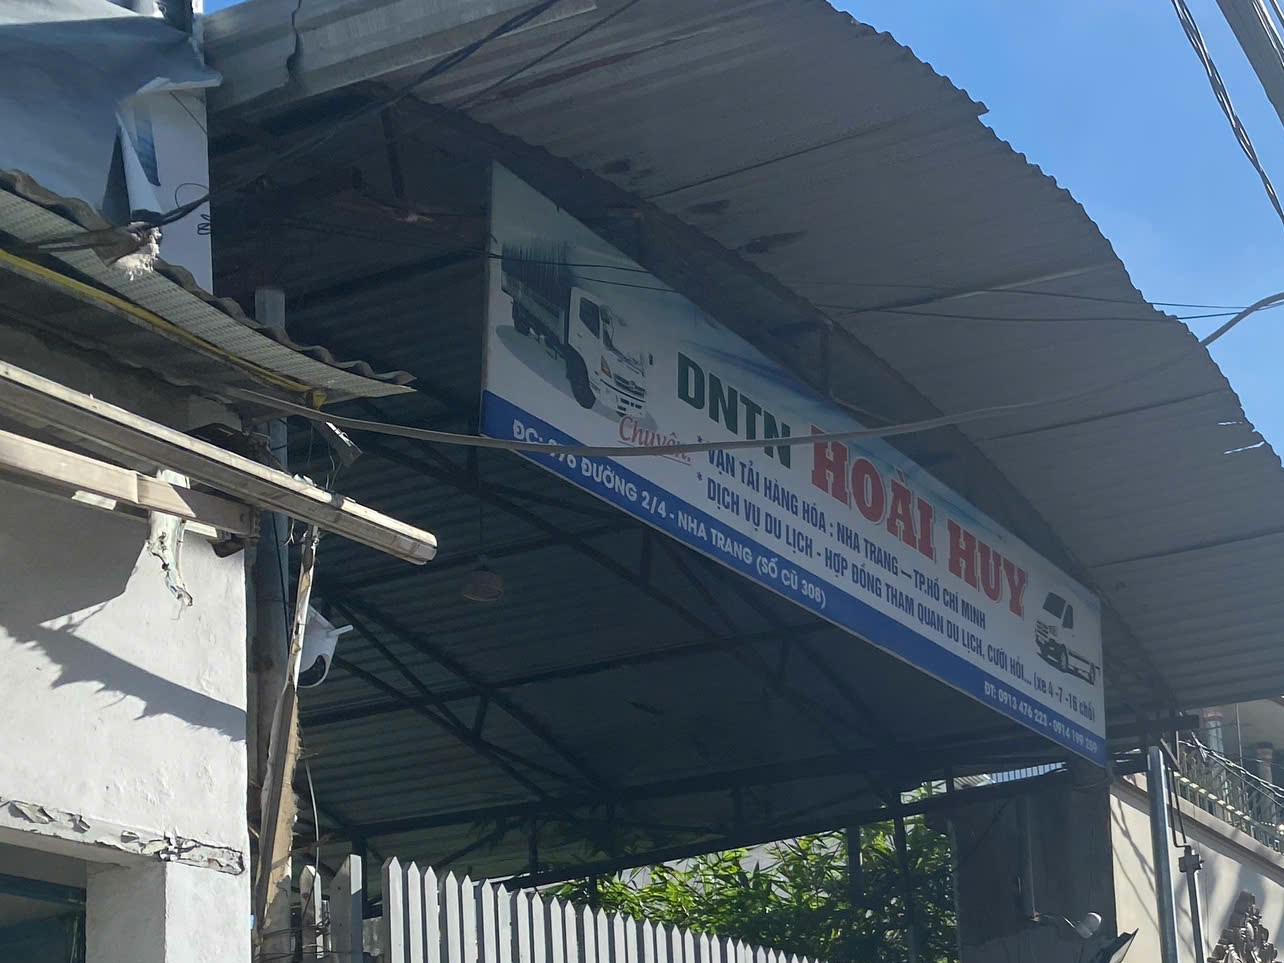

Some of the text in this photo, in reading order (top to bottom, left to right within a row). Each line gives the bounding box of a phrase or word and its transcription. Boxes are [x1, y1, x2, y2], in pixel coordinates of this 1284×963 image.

[580, 457, 638, 502] ĐƯỜNG
[641, 490, 667, 520] 2/4
[677, 510, 708, 541] NHA
[710, 527, 753, 565] TRANG
[755, 555, 778, 579] (SỐ
[780, 568, 798, 591] CŨ
[801, 579, 826, 609] 308)
[678, 352, 1028, 618] DNTN HOÀI HUY
[740, 460, 760, 494] TẢI
[764, 476, 798, 516] HÀNG
[837, 521, 861, 554] NHA
[863, 538, 899, 577] TRANG
[942, 588, 959, 614] CHÍ
[961, 599, 986, 630] MINH
[707, 476, 740, 516] DỊCH
[744, 498, 761, 532] VỤ
[765, 511, 782, 540] DU
[785, 523, 813, 559] LỊCH
[825, 547, 848, 579] HỢP
[851, 562, 882, 599] ĐỒNG
[885, 582, 915, 617] THAM
[917, 602, 944, 635] QUAN
[946, 619, 960, 643] DU
[961, 628, 985, 659] LỊCH,
[987, 643, 1008, 672] CƯỚI
[984, 680, 997, 699] ĐT:
[998, 688, 1017, 711] 0913
